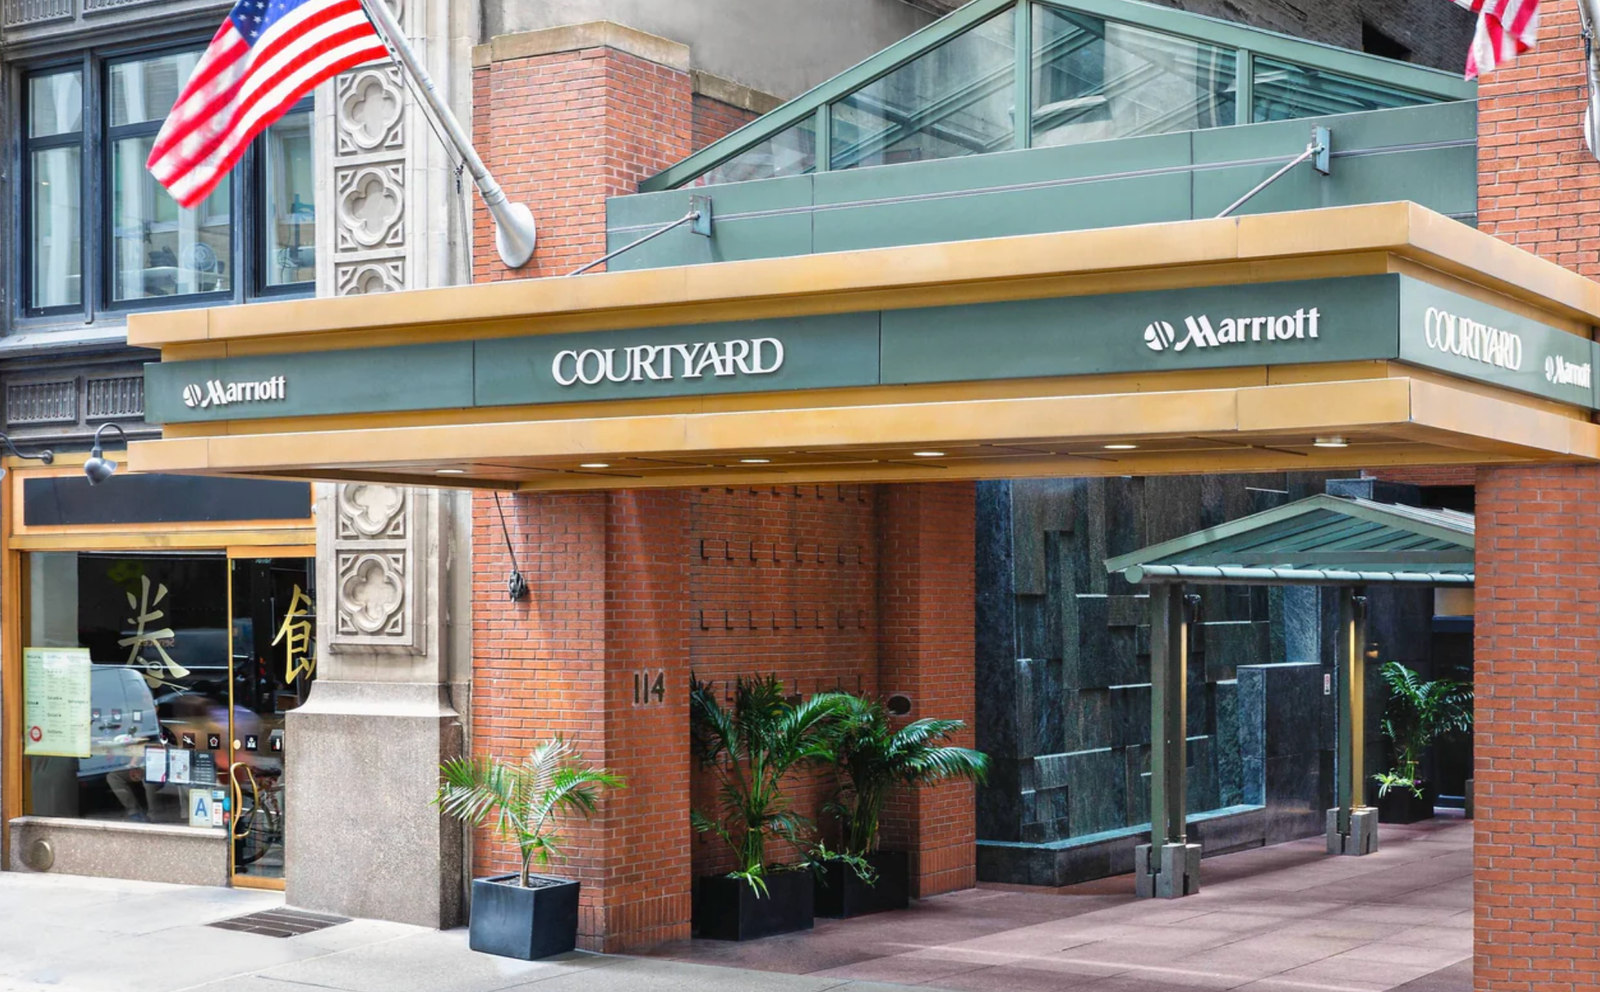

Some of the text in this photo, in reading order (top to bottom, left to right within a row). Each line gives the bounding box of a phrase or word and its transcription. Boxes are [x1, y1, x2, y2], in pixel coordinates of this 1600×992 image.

[1174, 307, 1320, 351] Marriott
[1425, 306, 1522, 371] COURTYARD
[551, 337, 784, 386] COURTYARD
[200, 375, 286, 408] Marriott
[634, 671, 665, 704] 114
[195, 798, 208, 817] A
